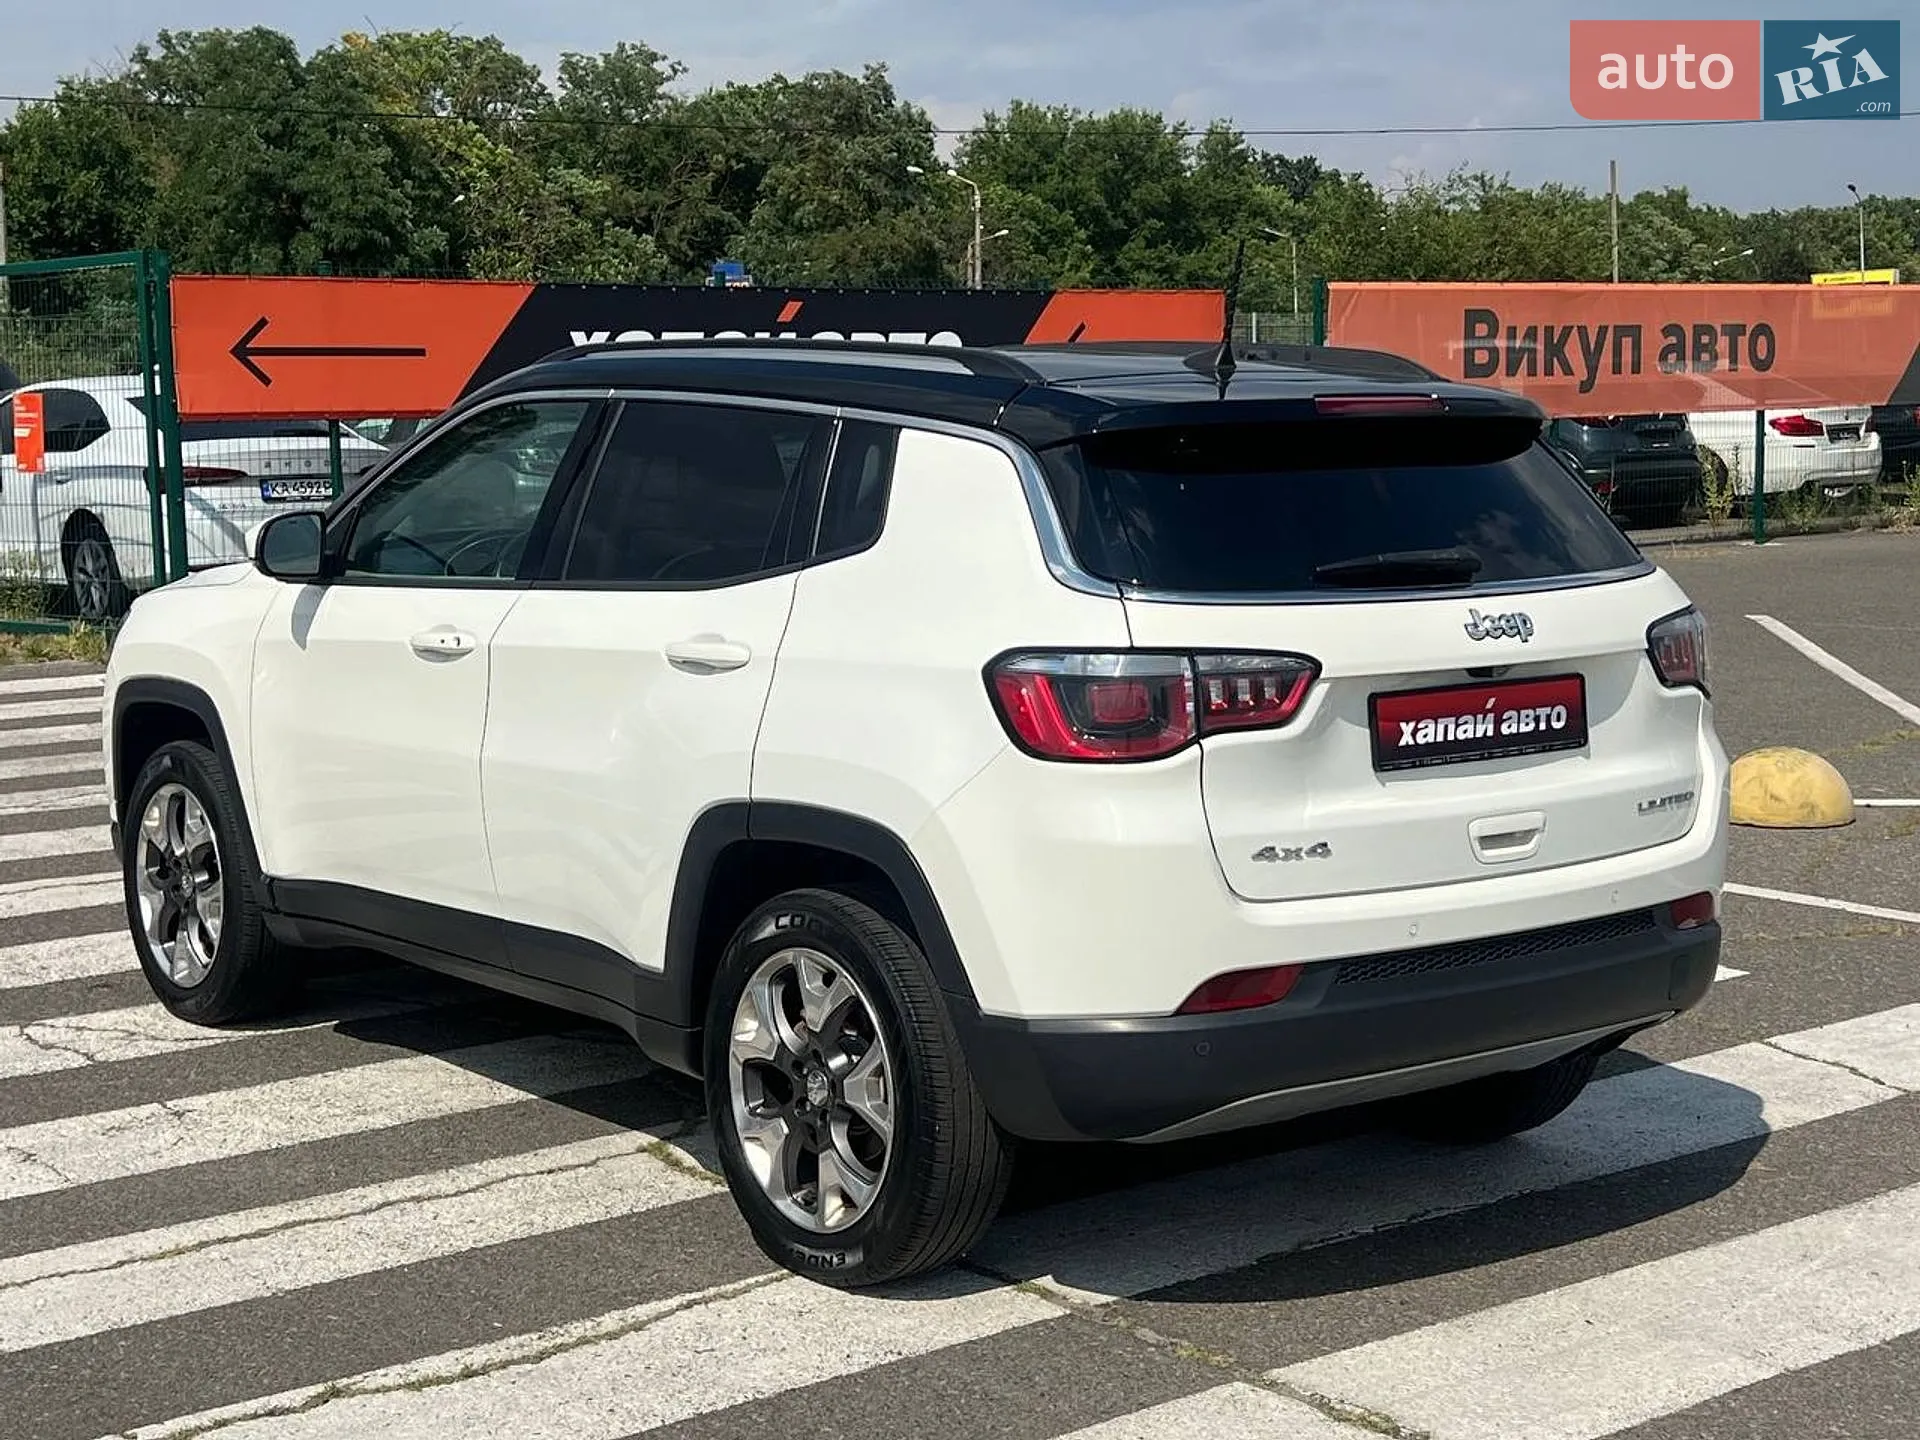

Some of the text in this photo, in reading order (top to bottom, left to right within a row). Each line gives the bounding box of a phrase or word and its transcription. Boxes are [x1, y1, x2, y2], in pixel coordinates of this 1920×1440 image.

[1464, 308, 1776, 393] Викуп авто
[1464, 608, 1534, 643] Jeep
[1500, 704, 1567, 735] авто
